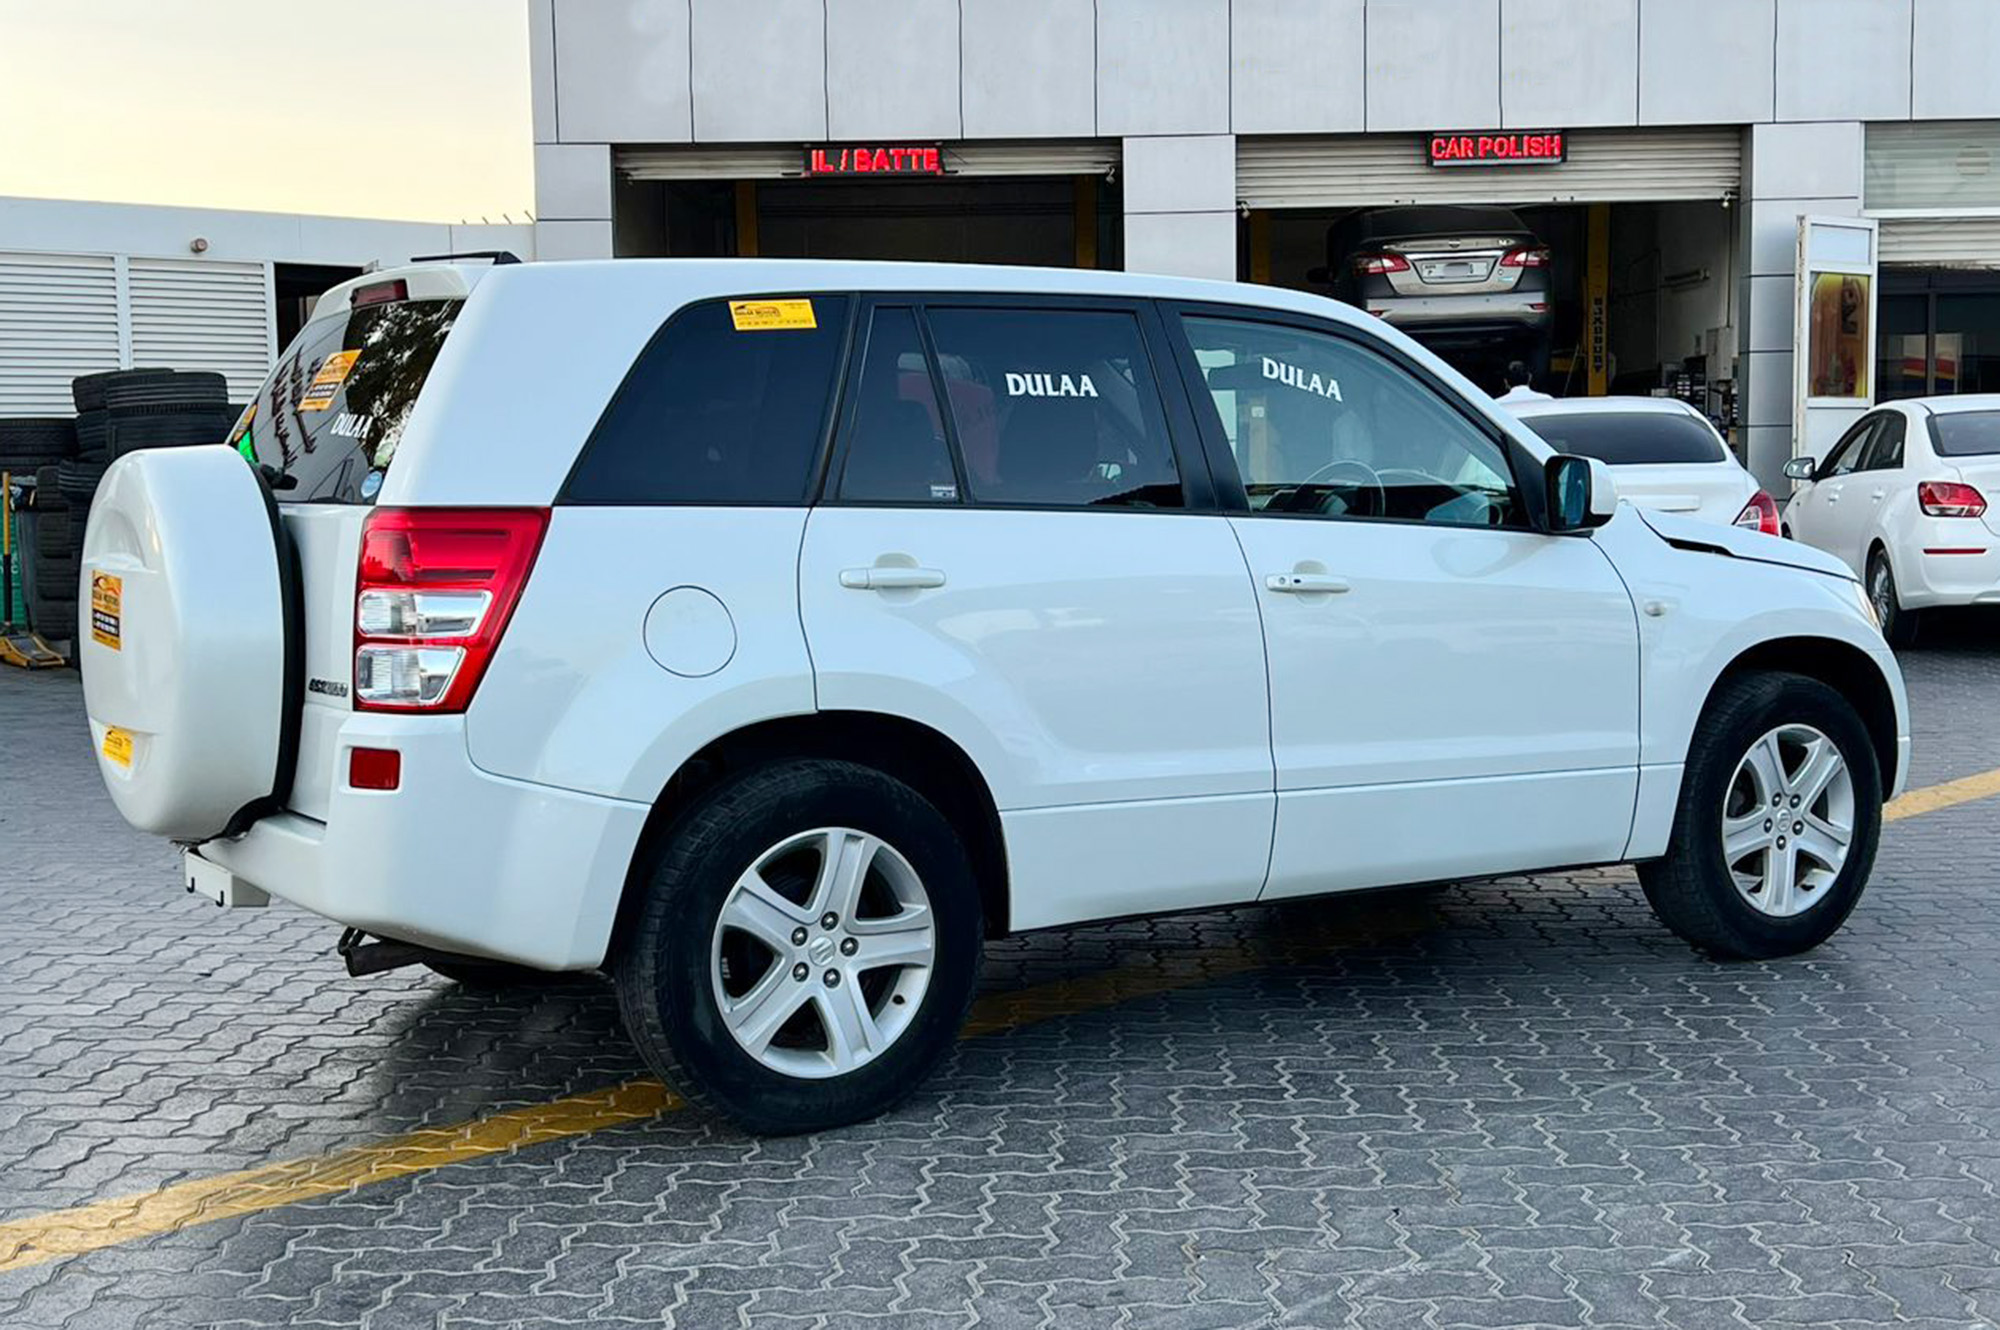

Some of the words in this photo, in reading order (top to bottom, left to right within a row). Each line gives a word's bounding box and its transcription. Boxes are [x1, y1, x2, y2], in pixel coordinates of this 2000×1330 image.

[1432, 136, 1475, 159] CAR
[1478, 134, 1561, 158] POLISH
[811, 149, 835, 172] IL
[854, 148, 939, 172] BATTE
[1004, 372, 1100, 398] DULAA
[1262, 356, 1343, 402] DULAA
[330, 412, 374, 439] DULAA
